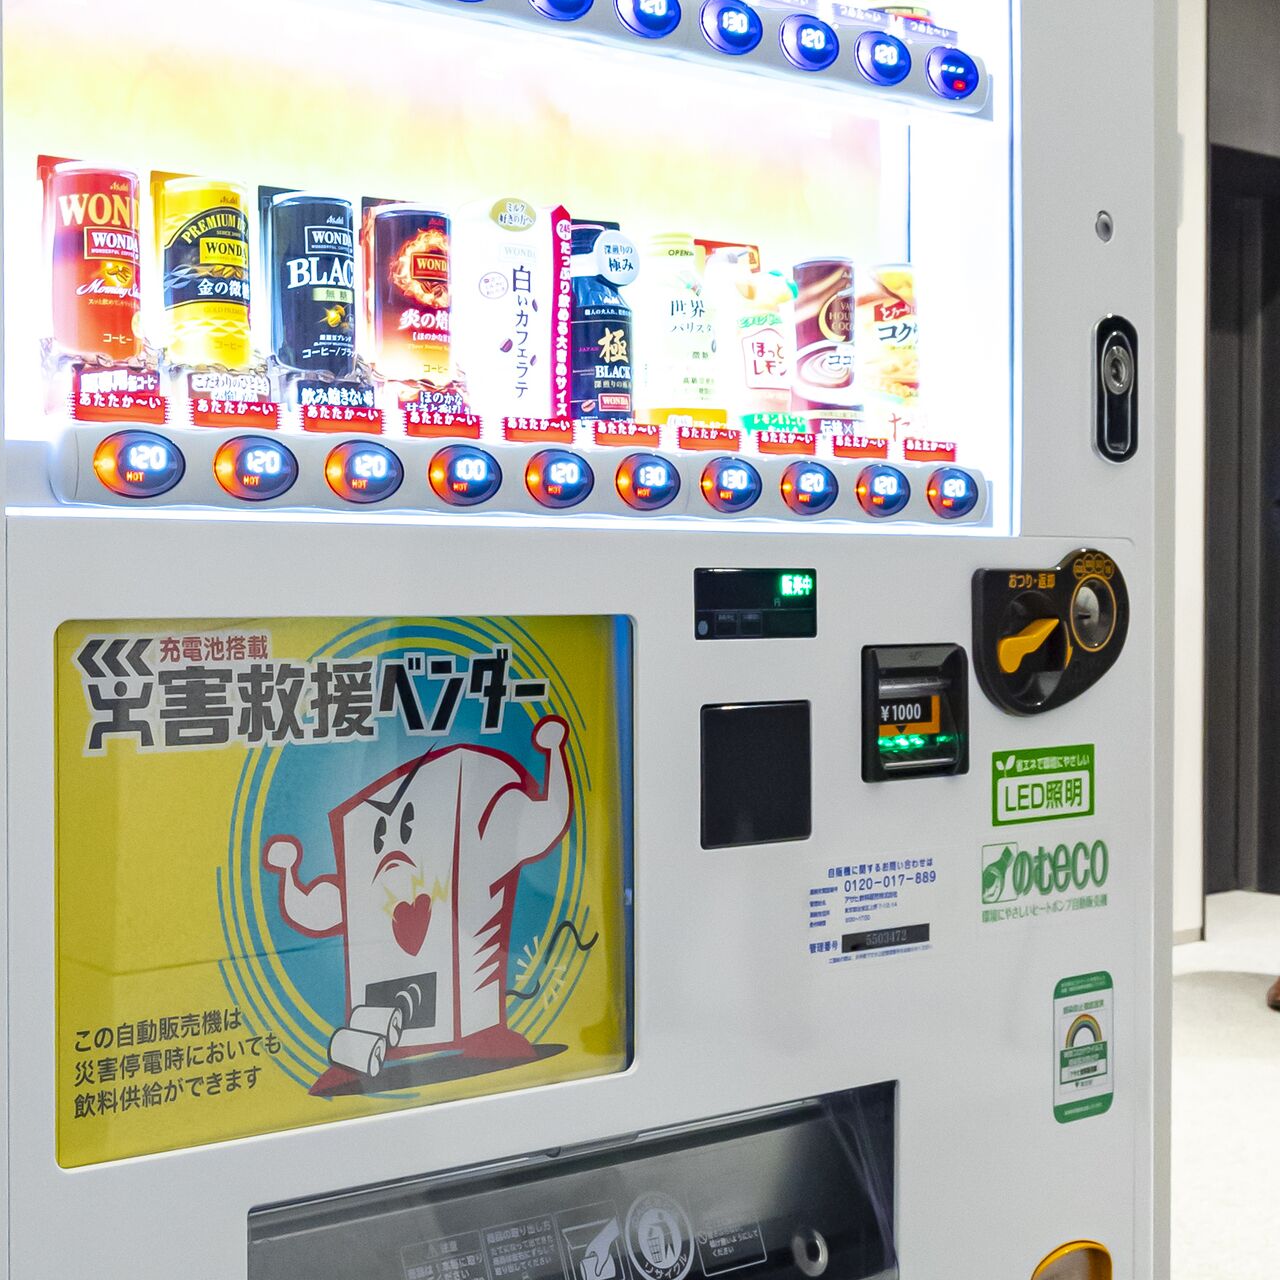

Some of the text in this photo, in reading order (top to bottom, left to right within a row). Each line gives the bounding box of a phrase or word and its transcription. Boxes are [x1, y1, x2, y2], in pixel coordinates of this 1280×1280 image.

[722, 12, 747, 34] 130
[505, 201, 526, 214] ミルク
[668, 249, 691, 257] OPEN
[103, 332, 132, 345] コーヒー
[512, 265, 532, 400] 白いカフェラテ
[597, 327, 629, 364] 極
[594, 364, 631, 379] BLACK
[130, 445, 167, 470] 120
[247, 450, 281, 474] 120
[355, 455, 387, 477] 120
[126, 471, 144, 483] HOT
[243, 475, 260, 486] HOT
[456, 459, 485, 482] 100
[550, 463, 576, 485] 120
[639, 466, 665, 487] 130
[721, 470, 748, 490] 130
[351, 479, 368, 489] HOT
[453, 482, 468, 492] HOT
[547, 484, 562, 494] HOT
[637, 487, 651, 497] HOT
[799, 473, 825, 493] 120
[873, 476, 897, 495] 120
[943, 478, 965, 497] 120
[719, 490, 733, 500] HOT
[798, 493, 811, 503] HOT
[872, 496, 885, 505] HOT
[942, 499, 954, 507] HOT
[780, 574, 813, 596] 販売中
[160, 636, 269, 662] 充電池搭載
[1005, 778, 1083, 813] LED照明
[828, 857, 933, 879] 自販機に関するお問い合わせは
[844, 870, 937, 893] 0120-017-889
[809, 939, 839, 955] 管理番号
[75, 1006, 242, 1054] この自動販売機は
[75, 1031, 282, 1087] 災害停電時においても
[74, 1065, 262, 1119] 飲料供給ができます
[644, 1253, 688, 1280] リサイクル
